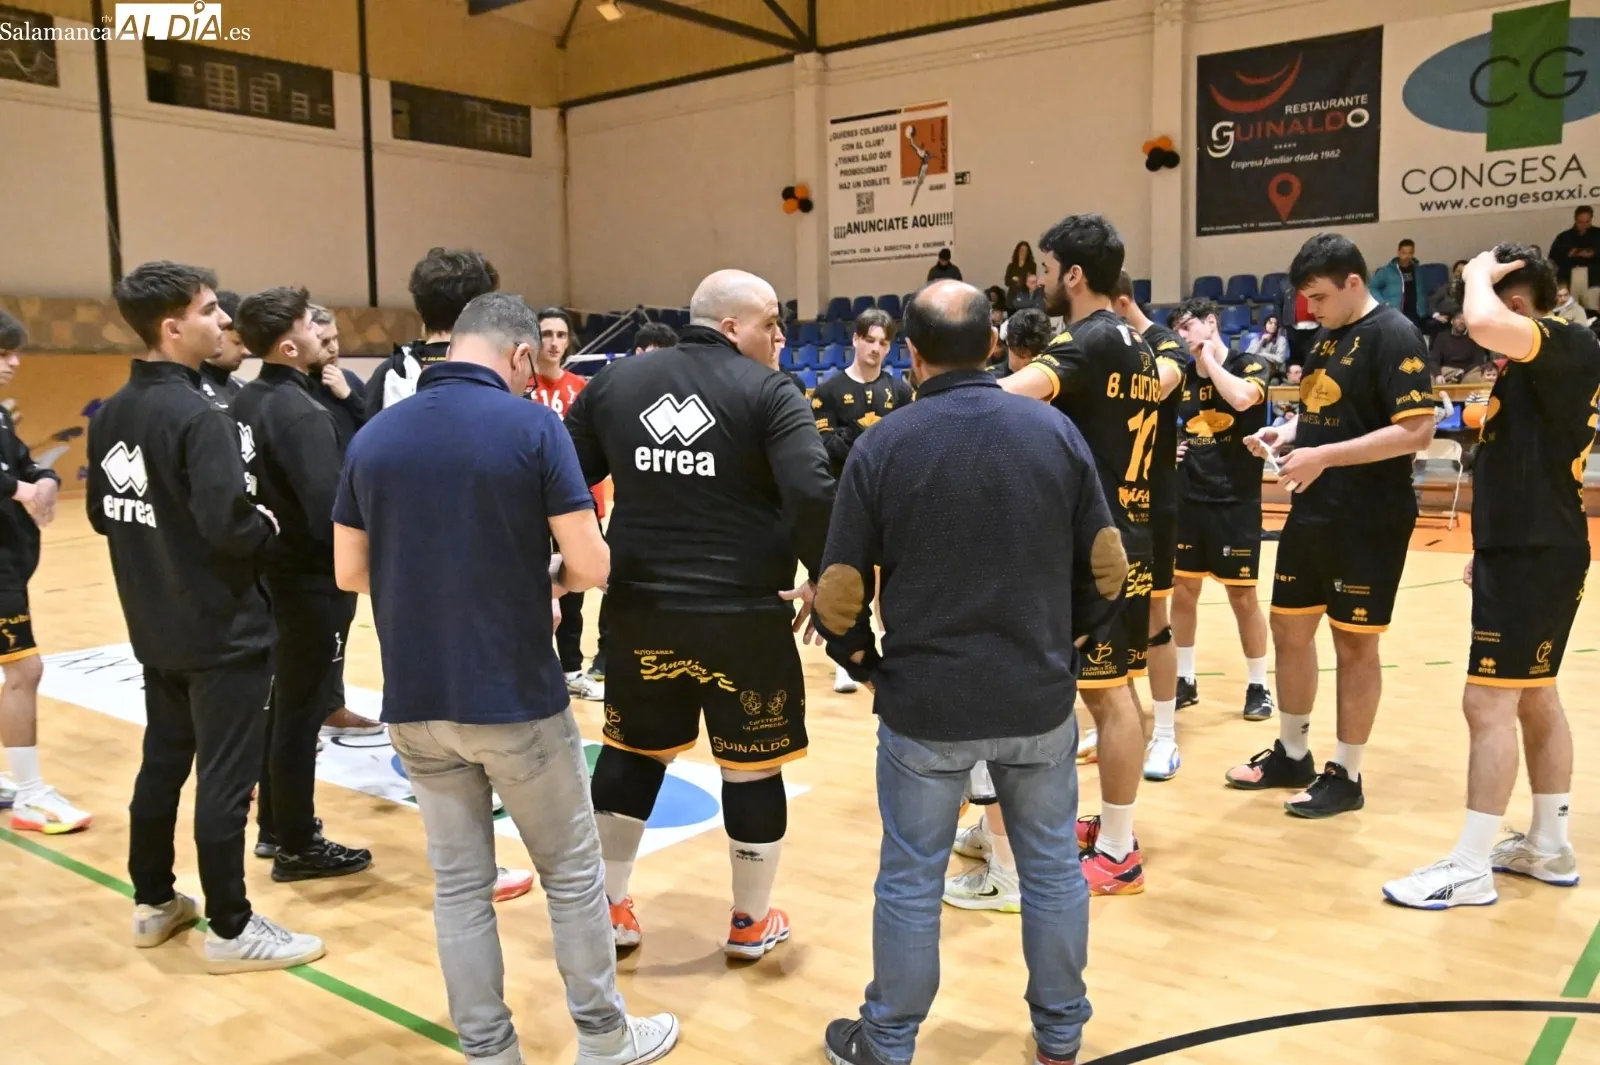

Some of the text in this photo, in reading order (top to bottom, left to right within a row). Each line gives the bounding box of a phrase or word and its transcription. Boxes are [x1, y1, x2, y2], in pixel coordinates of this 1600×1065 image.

[1470, 46, 1588, 109] CG
[1285, 94, 1368, 115] RESTAURANTE
[860, 123, 897, 136] COLABORAR
[1207, 108, 1370, 159] GUINALDO
[841, 138, 885, 151] CON EL CLUB?
[861, 152, 877, 162] ALGO
[879, 150, 892, 159] QUE
[1231, 149, 1341, 170] Empresa familiar desde 1982
[840, 164, 888, 177] PROMOCIONAR?
[1402, 153, 1587, 195] CONGESA
[839, 177, 891, 190] HAZ UN DOBLETE
[1320, 339, 1338, 356] 94
[540, 388, 564, 414] 16
[1199, 385, 1213, 401] 67
[634, 446, 716, 477] errea
[103, 494, 157, 529] errea
[713, 736, 790, 753] GUINALDO
